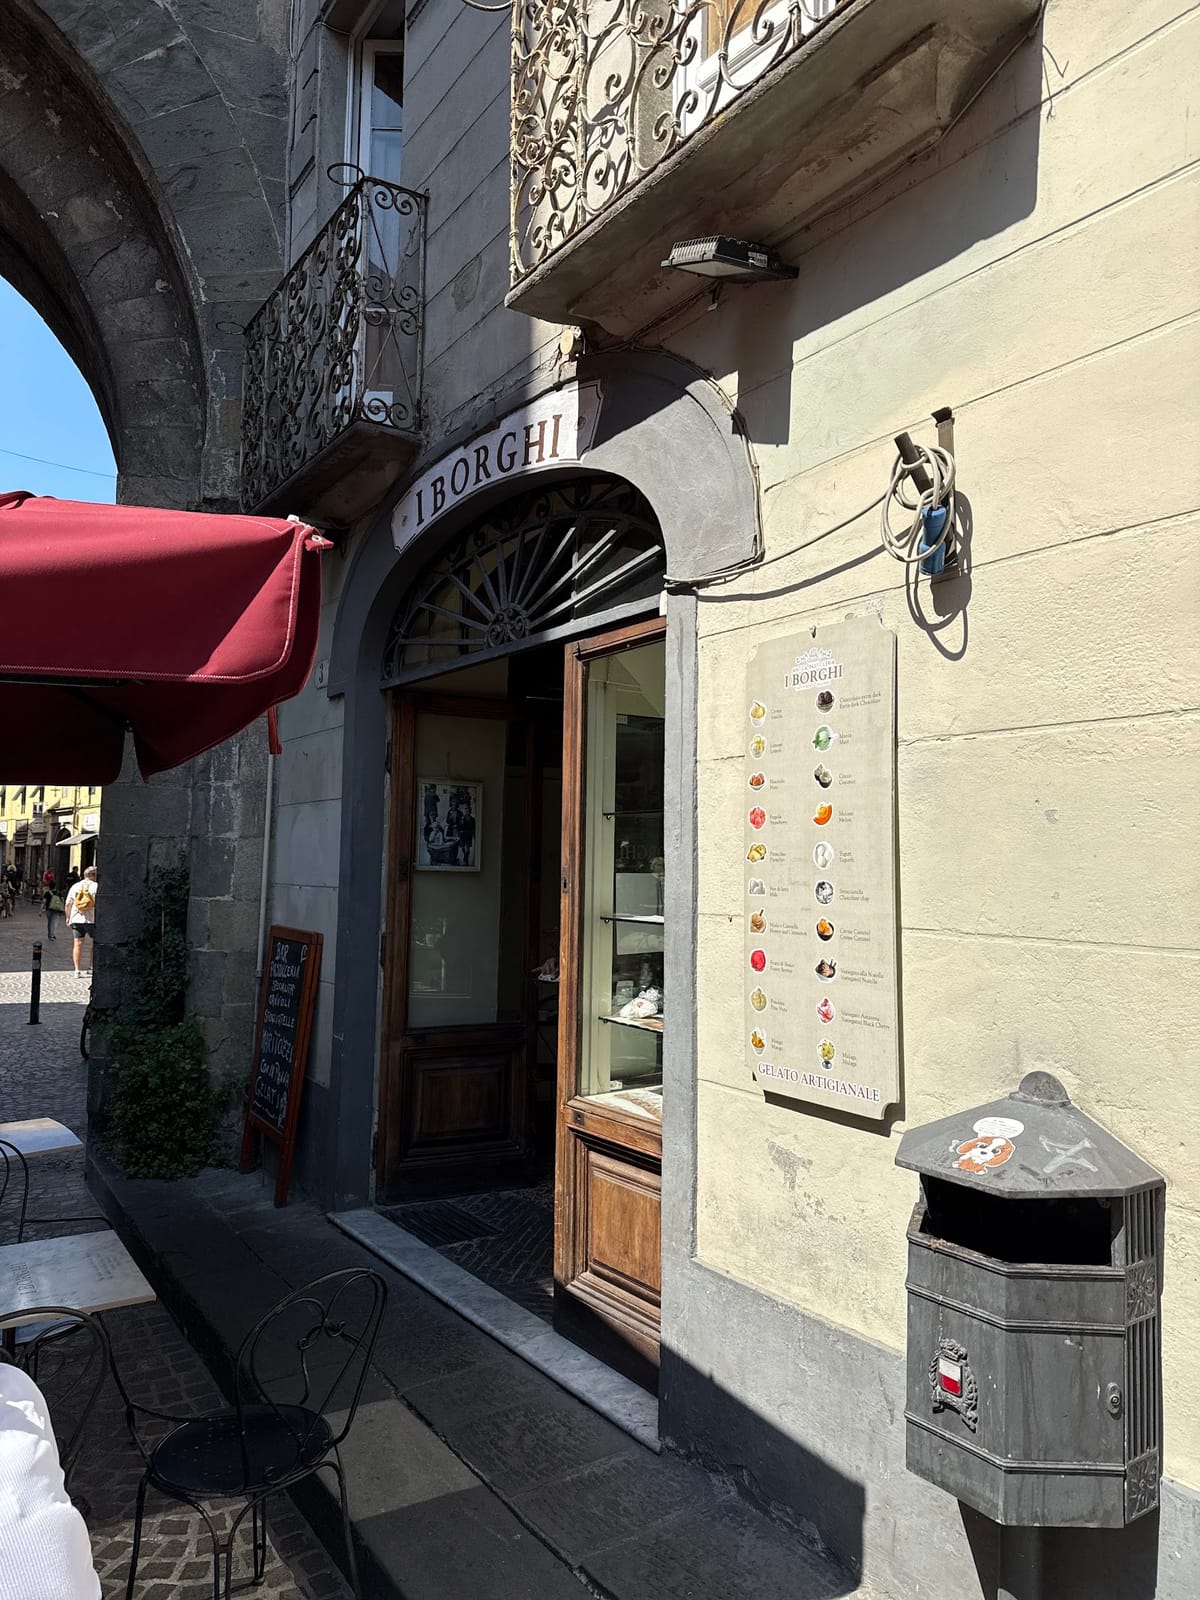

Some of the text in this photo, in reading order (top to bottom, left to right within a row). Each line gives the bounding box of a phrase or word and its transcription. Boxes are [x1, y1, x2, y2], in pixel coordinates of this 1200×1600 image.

[416, 414, 563, 527] I BORGHI
[785, 675, 788, 688] I
[792, 665, 842, 686] BORGHI
[758, 1062, 880, 1103] GELATO ARTIGIANALE
